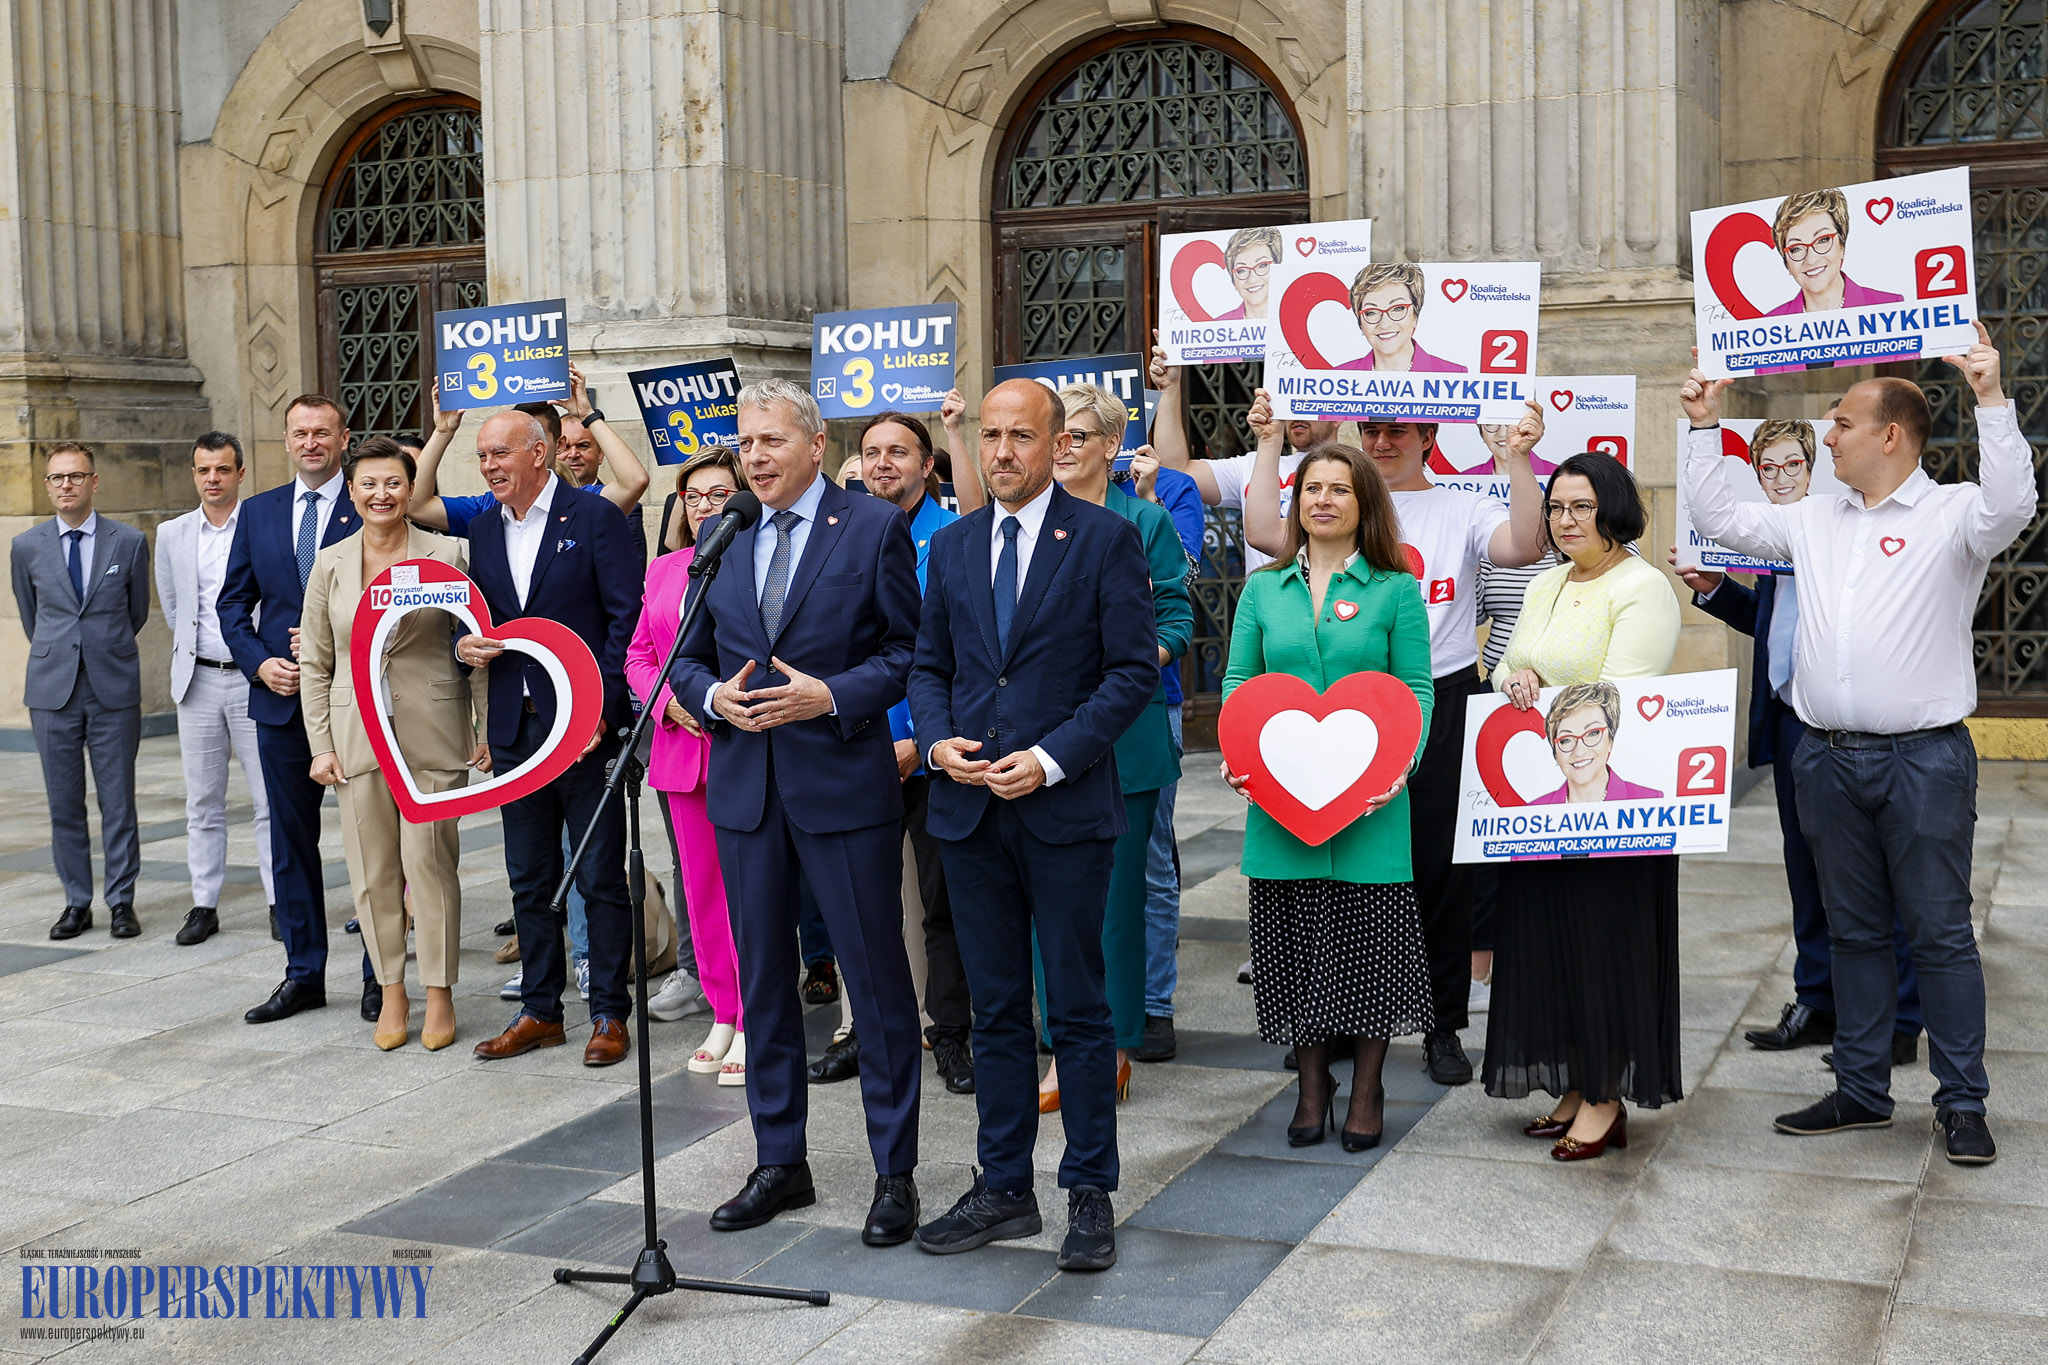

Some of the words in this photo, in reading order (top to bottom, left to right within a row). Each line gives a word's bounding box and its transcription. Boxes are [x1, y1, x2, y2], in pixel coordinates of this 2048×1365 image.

[1897, 197, 1936, 210] Koalicja
[1897, 203, 1963, 219] Obywatelska
[1318, 240, 1347, 249] Koalicja
[1318, 246, 1366, 255] Obywatelska
[1926, 253, 1956, 292] 2
[1470, 284, 1507, 294] Koalicja
[1470, 292, 1531, 302] Obywatelska
[442, 312, 563, 350] KOHUT
[820, 316, 952, 354] KOHUT
[1171, 326, 1266, 344] MIROSŁAW
[1712, 318, 1851, 351] MIROSŁAWA
[1858, 303, 1970, 335] NYKIEL
[503, 345, 563, 362] Łukasz
[883, 351, 949, 369] Łukasz
[1184, 348, 1238, 358] BEZPIECZNA
[1239, 346, 1266, 356] POLS
[1490, 335, 1518, 368] 2
[1729, 353, 1799, 368] BEZPIECZNA
[1800, 347, 1849, 361] POLSKA
[1849, 344, 1863, 356] W
[1863, 338, 1919, 355] EUROPIE
[467, 352, 498, 400] 3
[524, 377, 550, 387] Koalicja
[841, 357, 874, 408] 3
[637, 370, 735, 408] KOHUT
[903, 385, 931, 395] Koalicja
[1278, 376, 1415, 398] MIROSŁAWA
[1423, 379, 1525, 400] NYKIEL
[1575, 395, 1608, 404] Koalicja
[1575, 401, 1629, 411] Obywatelska
[1294, 402, 1363, 414] BEZPIECZNA
[1364, 403, 1412, 415] POLSKA
[1412, 405, 1425, 415] W
[1424, 405, 1477, 418] EUROPIE
[668, 410, 700, 455] 3
[1704, 554, 1765, 567] BEZPIECZNA
[373, 589, 392, 606] 10
[393, 586, 423, 594] Krzysztof
[1436, 582, 1448, 600] 2
[394, 592, 467, 606] GADOWSKI
[1667, 697, 1705, 708] Koalicja
[1667, 704, 1729, 718] Obywatelska
[1687, 752, 1715, 789] 2
[1471, 811, 1609, 837] MIROSŁAWA
[1617, 804, 1723, 829] NYKIEL
[1487, 841, 1556, 855] BEZPIECZNA
[1556, 839, 1604, 851] POLSKA
[1605, 838, 1619, 849] W
[1618, 835, 1672, 849] EUROPIE
